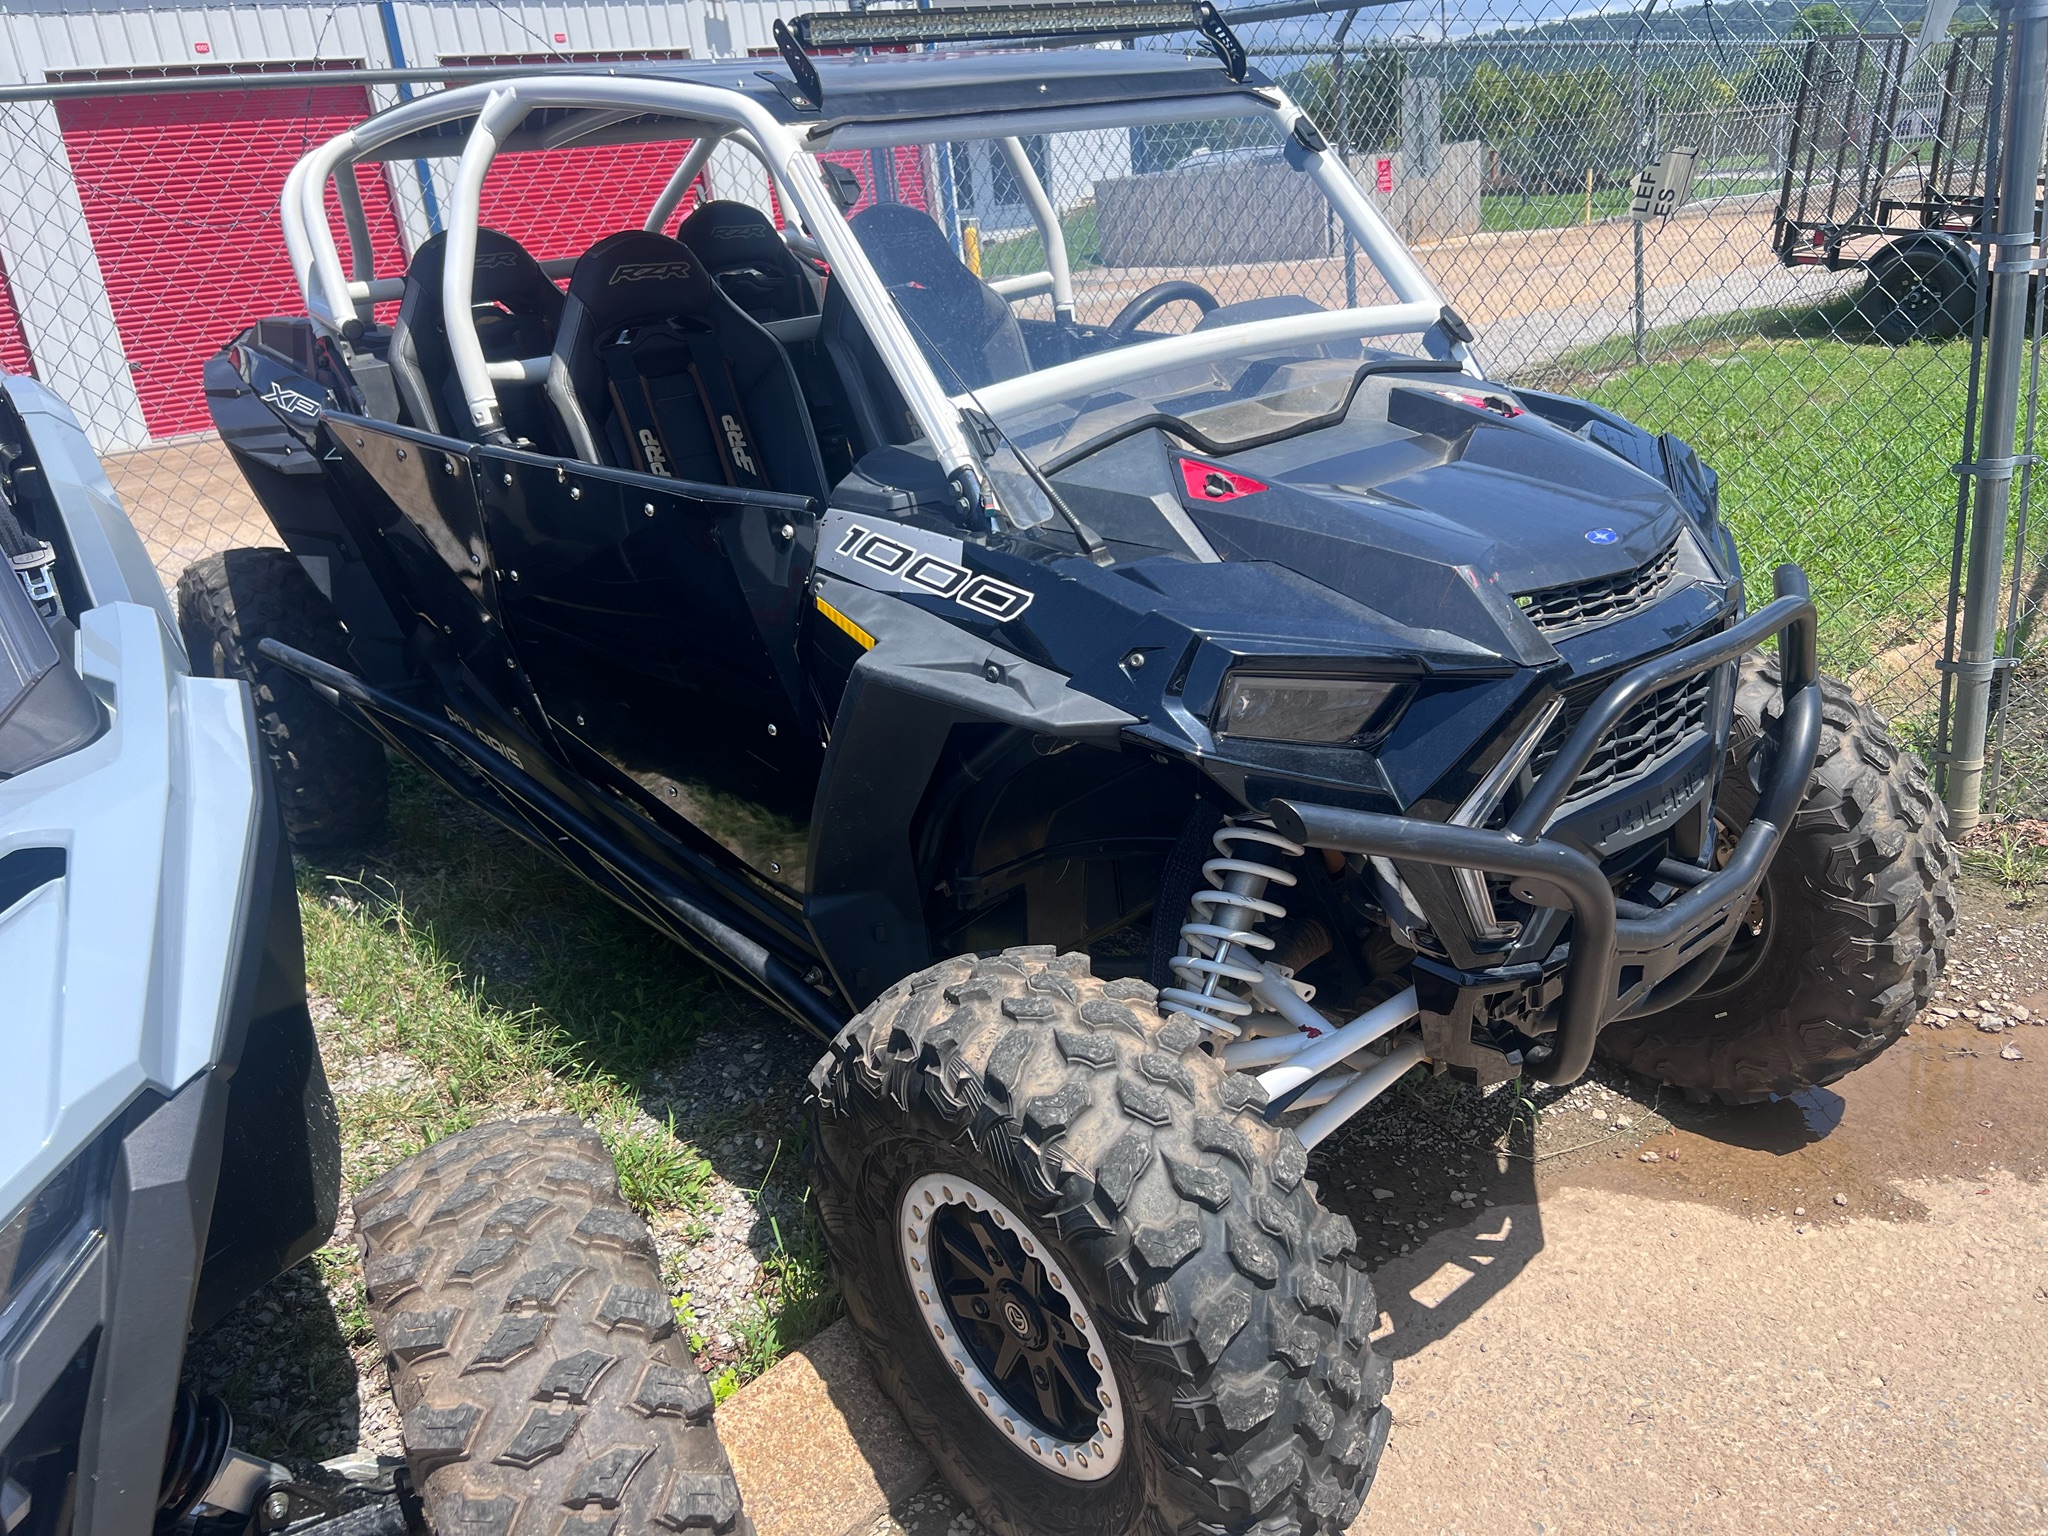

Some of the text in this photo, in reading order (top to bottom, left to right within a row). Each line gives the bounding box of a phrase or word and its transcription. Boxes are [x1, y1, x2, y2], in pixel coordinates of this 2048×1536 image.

[1632, 163, 1660, 212] LEF
[1653, 189, 1675, 216] ES
[711, 225, 766, 240] RZR
[475, 251, 518, 269] ZR
[609, 261, 692, 285] RZR
[260, 381, 322, 417] XP
[721, 414, 757, 477] PRP
[835, 524, 1035, 622] 1000
[1598, 761, 1706, 847] POLARIS
